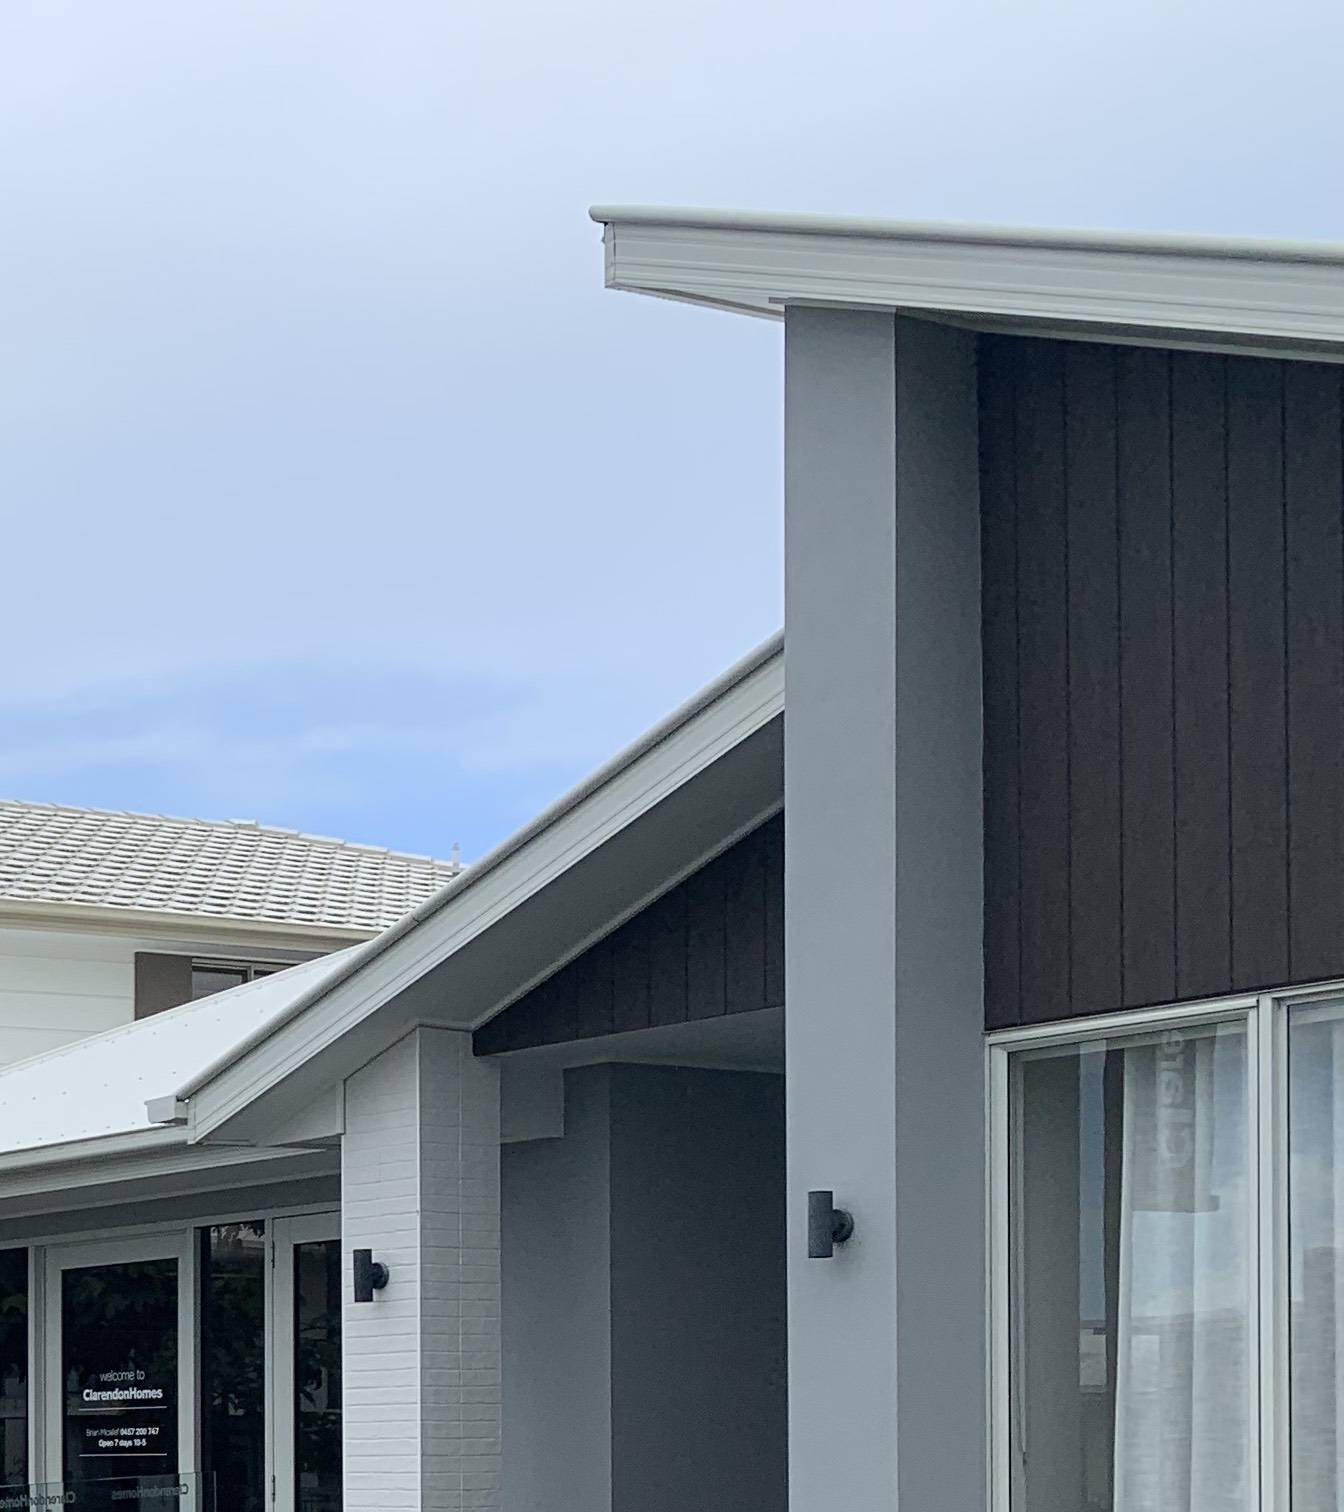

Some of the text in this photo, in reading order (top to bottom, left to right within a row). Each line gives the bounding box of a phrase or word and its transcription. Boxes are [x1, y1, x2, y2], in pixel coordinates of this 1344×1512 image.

[100, 1369, 145, 1382] welcome to
[83, 1388, 163, 1401] ClarendonHomes
[98, 1439, 114, 1448] Open
[114, 1438, 119, 1447] 7
[119, 1439, 133, 1448] days
